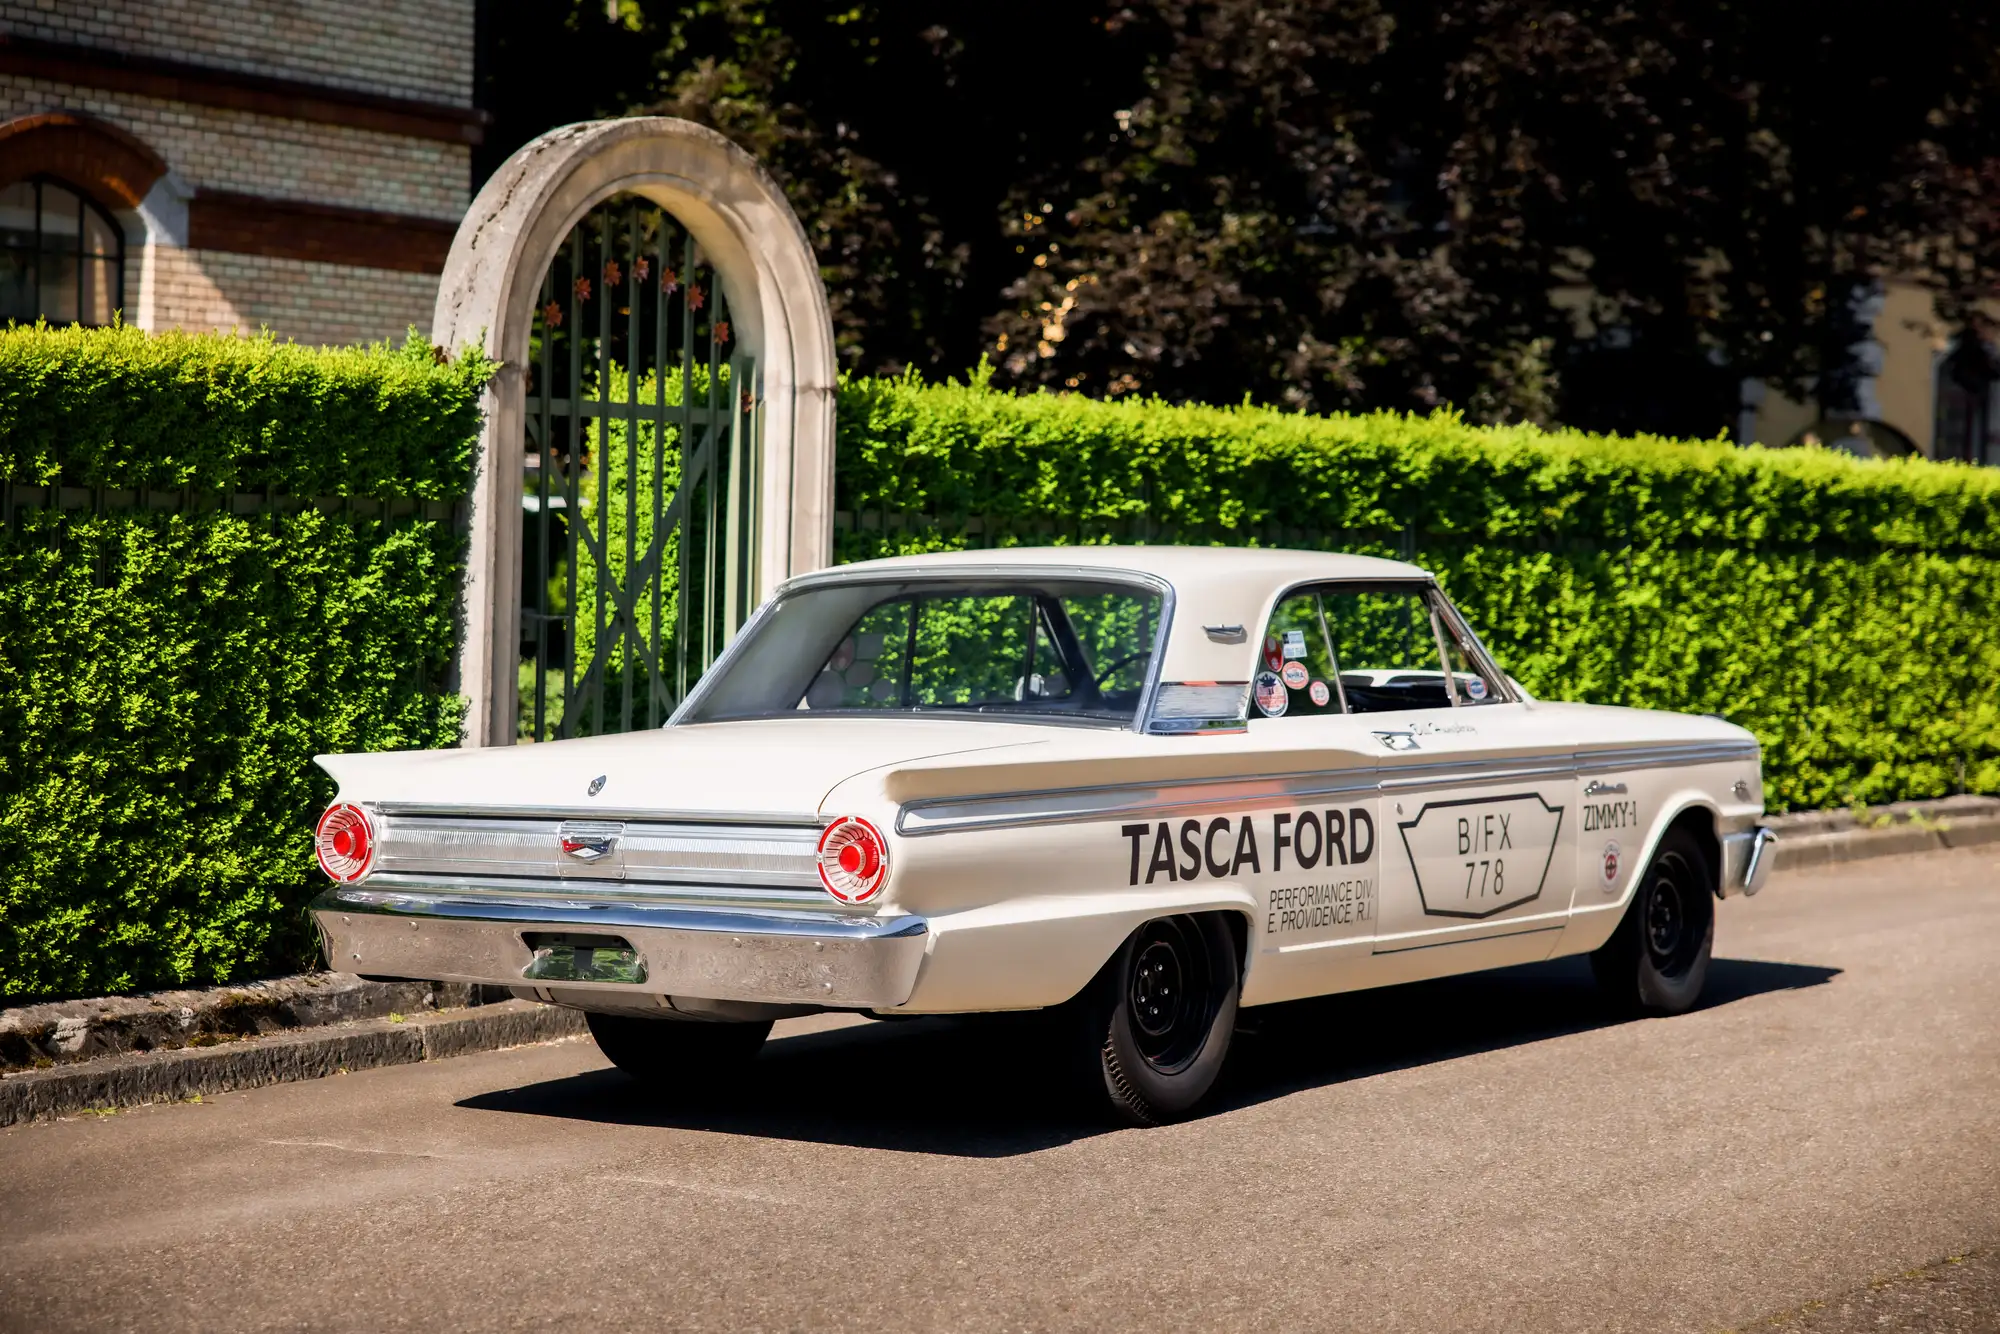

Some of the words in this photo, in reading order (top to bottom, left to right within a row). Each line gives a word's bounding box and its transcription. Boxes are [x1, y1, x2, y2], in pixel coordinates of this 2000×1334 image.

[1121, 815, 1261, 886] TASCA
[1273, 807, 1375, 872] FORD
[1457, 813, 1512, 856] B/FX
[1269, 881, 1353, 911] PERFORMANCE
[1465, 858, 1505, 899] 778
[1267, 912, 1277, 934] E.
